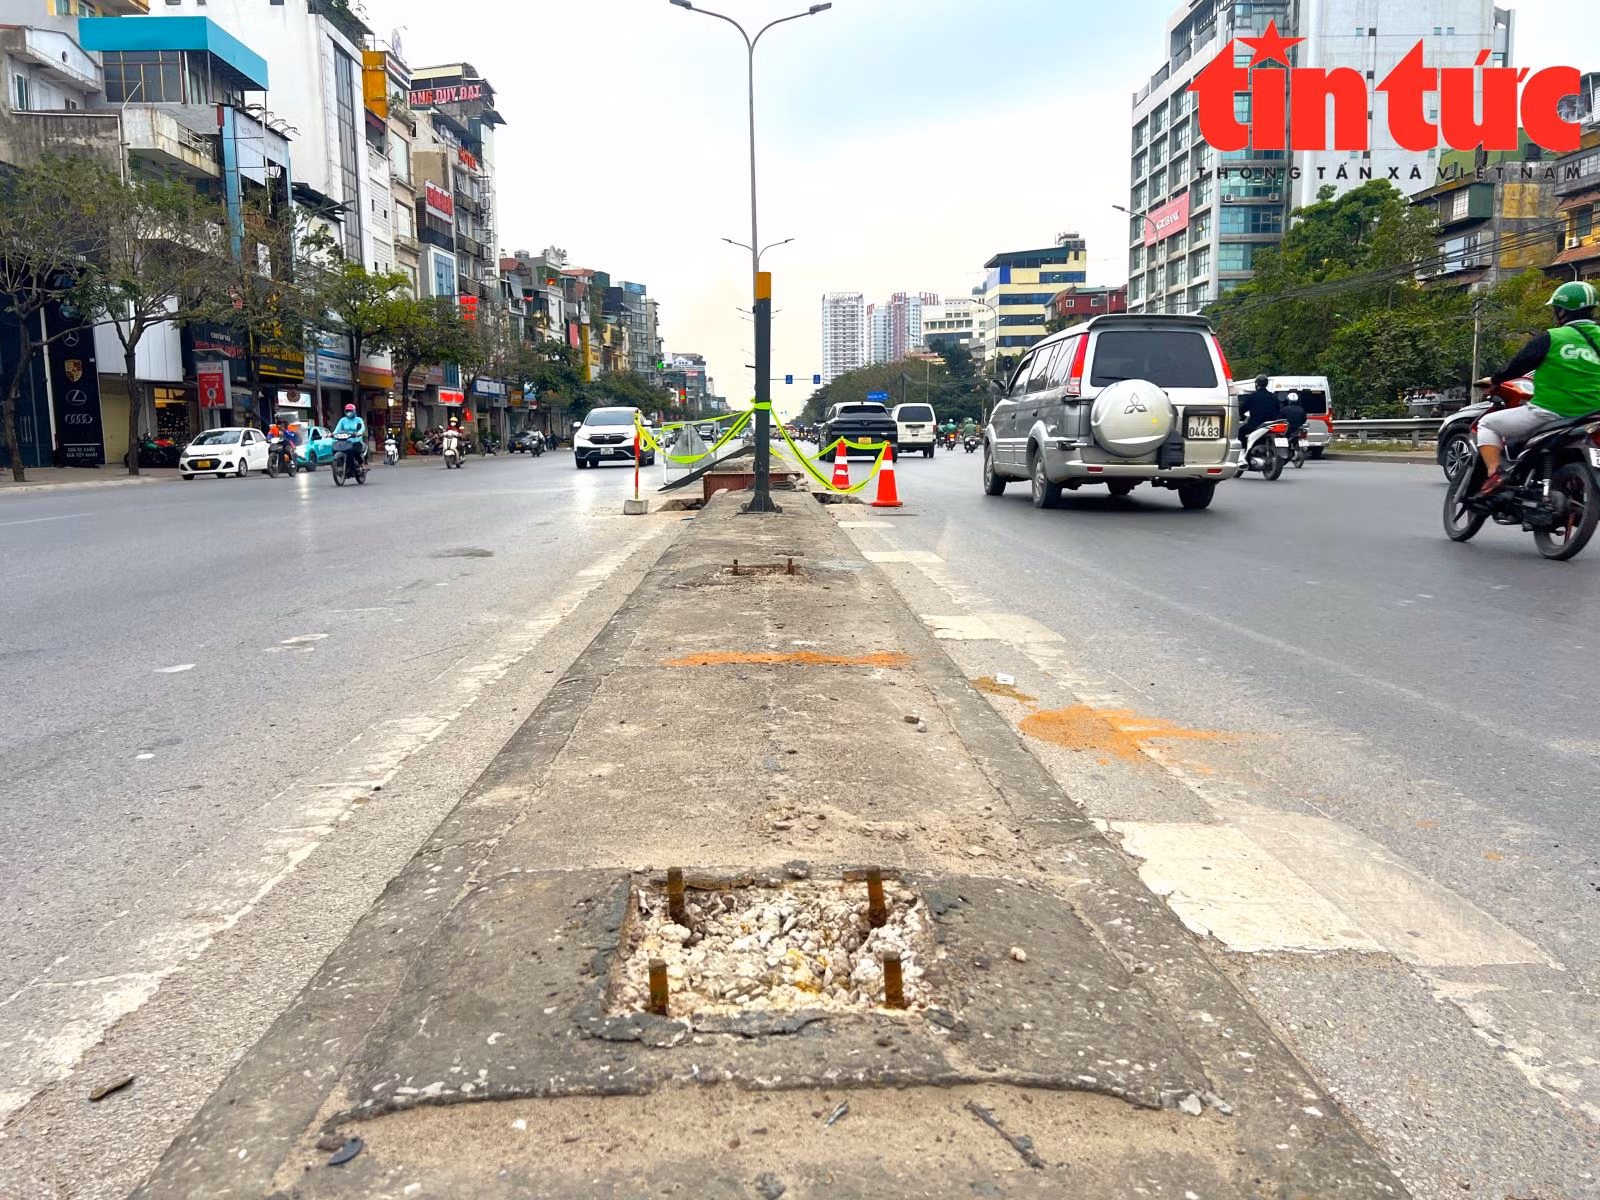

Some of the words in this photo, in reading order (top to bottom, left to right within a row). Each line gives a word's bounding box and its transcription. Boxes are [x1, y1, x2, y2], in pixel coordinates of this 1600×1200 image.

[435, 88, 457, 103] DUY
[1197, 416, 1213, 427] 17A
[1189, 427, 1219, 437] 044.83
